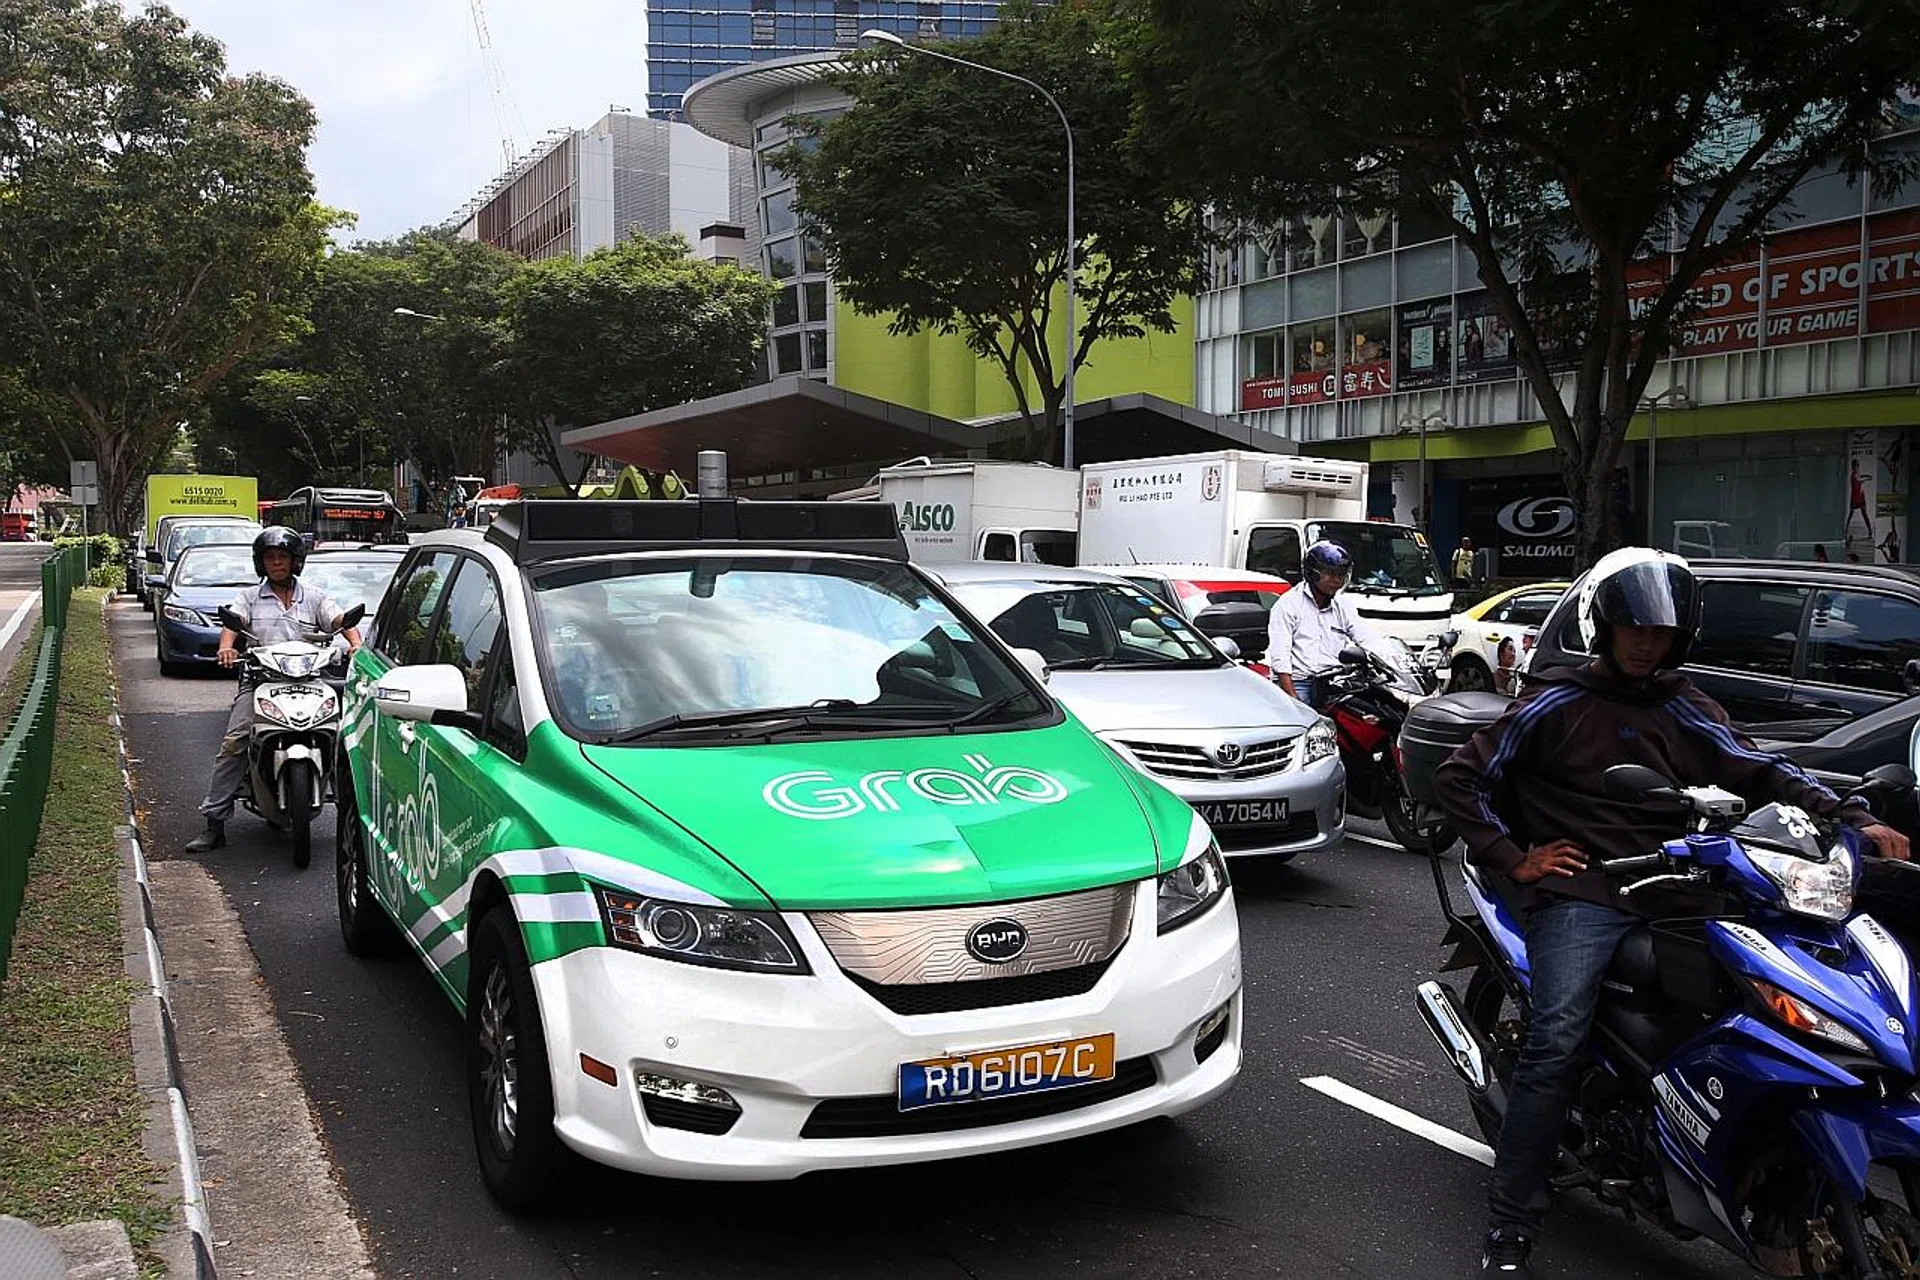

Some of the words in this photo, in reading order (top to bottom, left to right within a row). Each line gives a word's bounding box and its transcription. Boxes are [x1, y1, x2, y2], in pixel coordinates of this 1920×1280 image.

[1743, 273, 1789, 301] OF
[1683, 326, 1729, 346] PLAY
[1736, 317, 1791, 341] YOUR
[1797, 309, 1859, 333] GAME
[1262, 387, 1284, 399] TOMI
[1290, 382, 1318, 396] SUSHI
[900, 501, 955, 532] ALSCO
[1501, 544, 1575, 558] SALOMO
[761, 753, 1069, 821] Grab
[1193, 802, 1286, 824] KA7054M
[976, 930, 1020, 948] BYD
[923, 1043, 1095, 1100] RD6107C
[1664, 1086, 1700, 1138] YAMAHA
